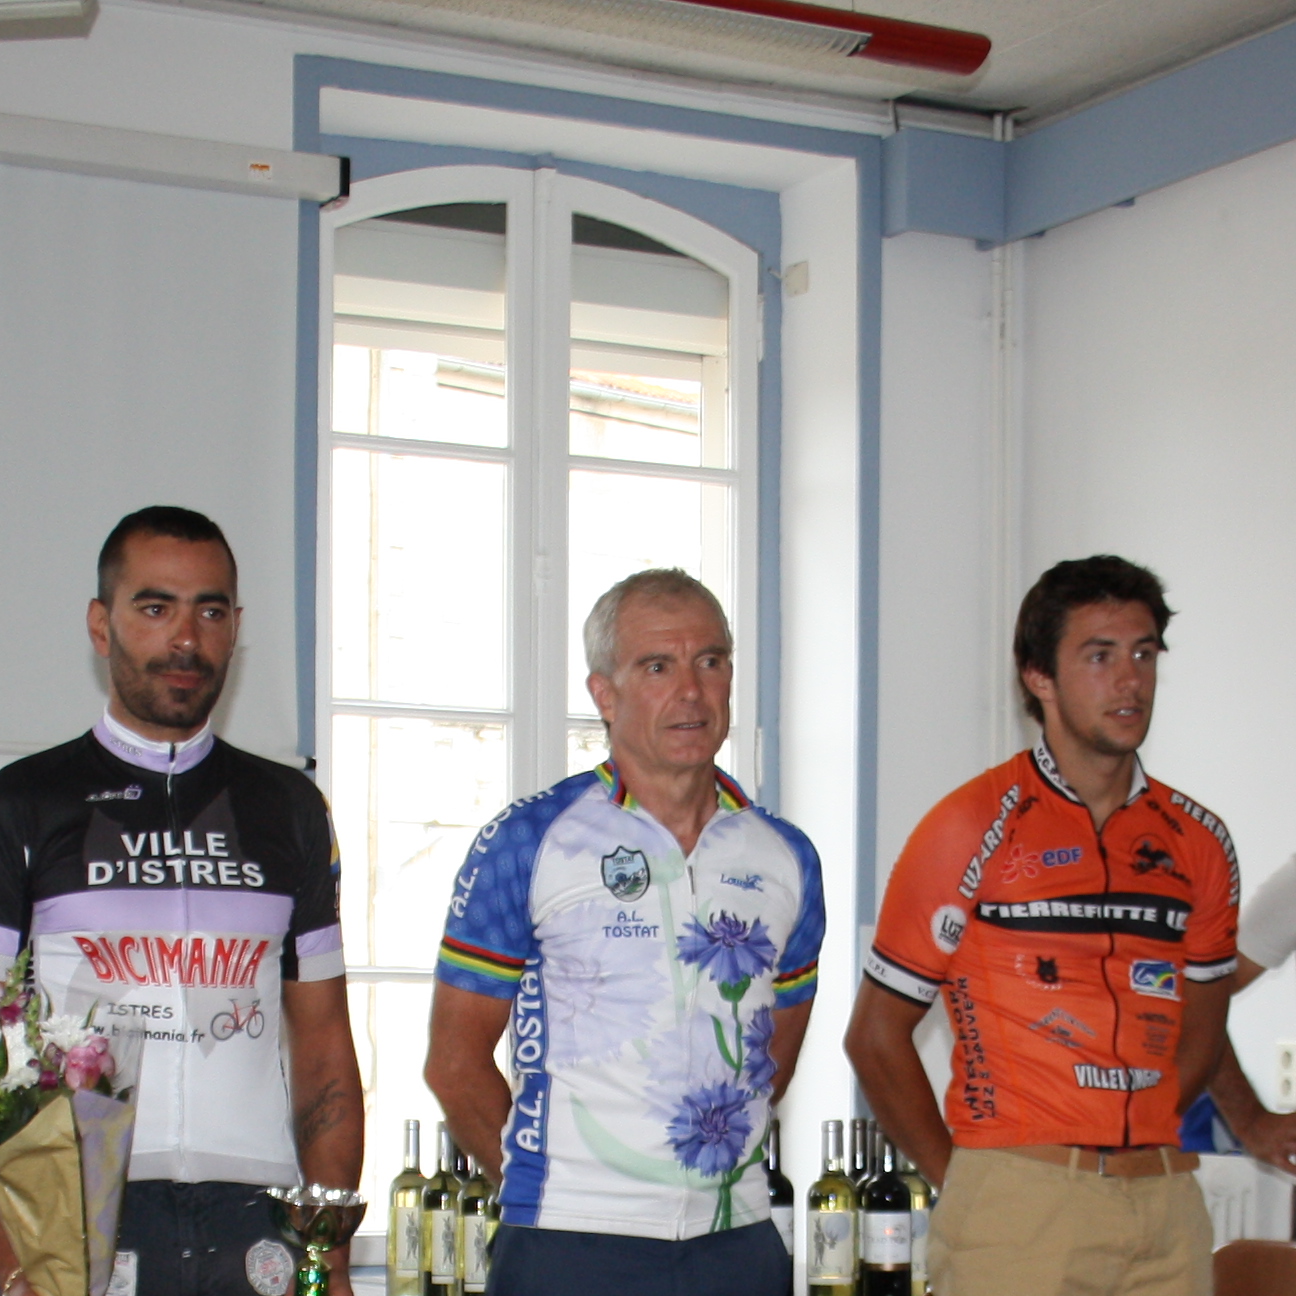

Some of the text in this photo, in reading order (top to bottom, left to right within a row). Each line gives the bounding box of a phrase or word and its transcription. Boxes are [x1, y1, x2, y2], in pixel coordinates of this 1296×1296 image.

[120, 830, 229, 859] VILLE
[87, 858, 266, 888] D'ISTRES
[602, 925, 661, 939] TOSTAT
[72, 935, 269, 989] BICIMANIA
[106, 1002, 174, 1019] ISTRES
